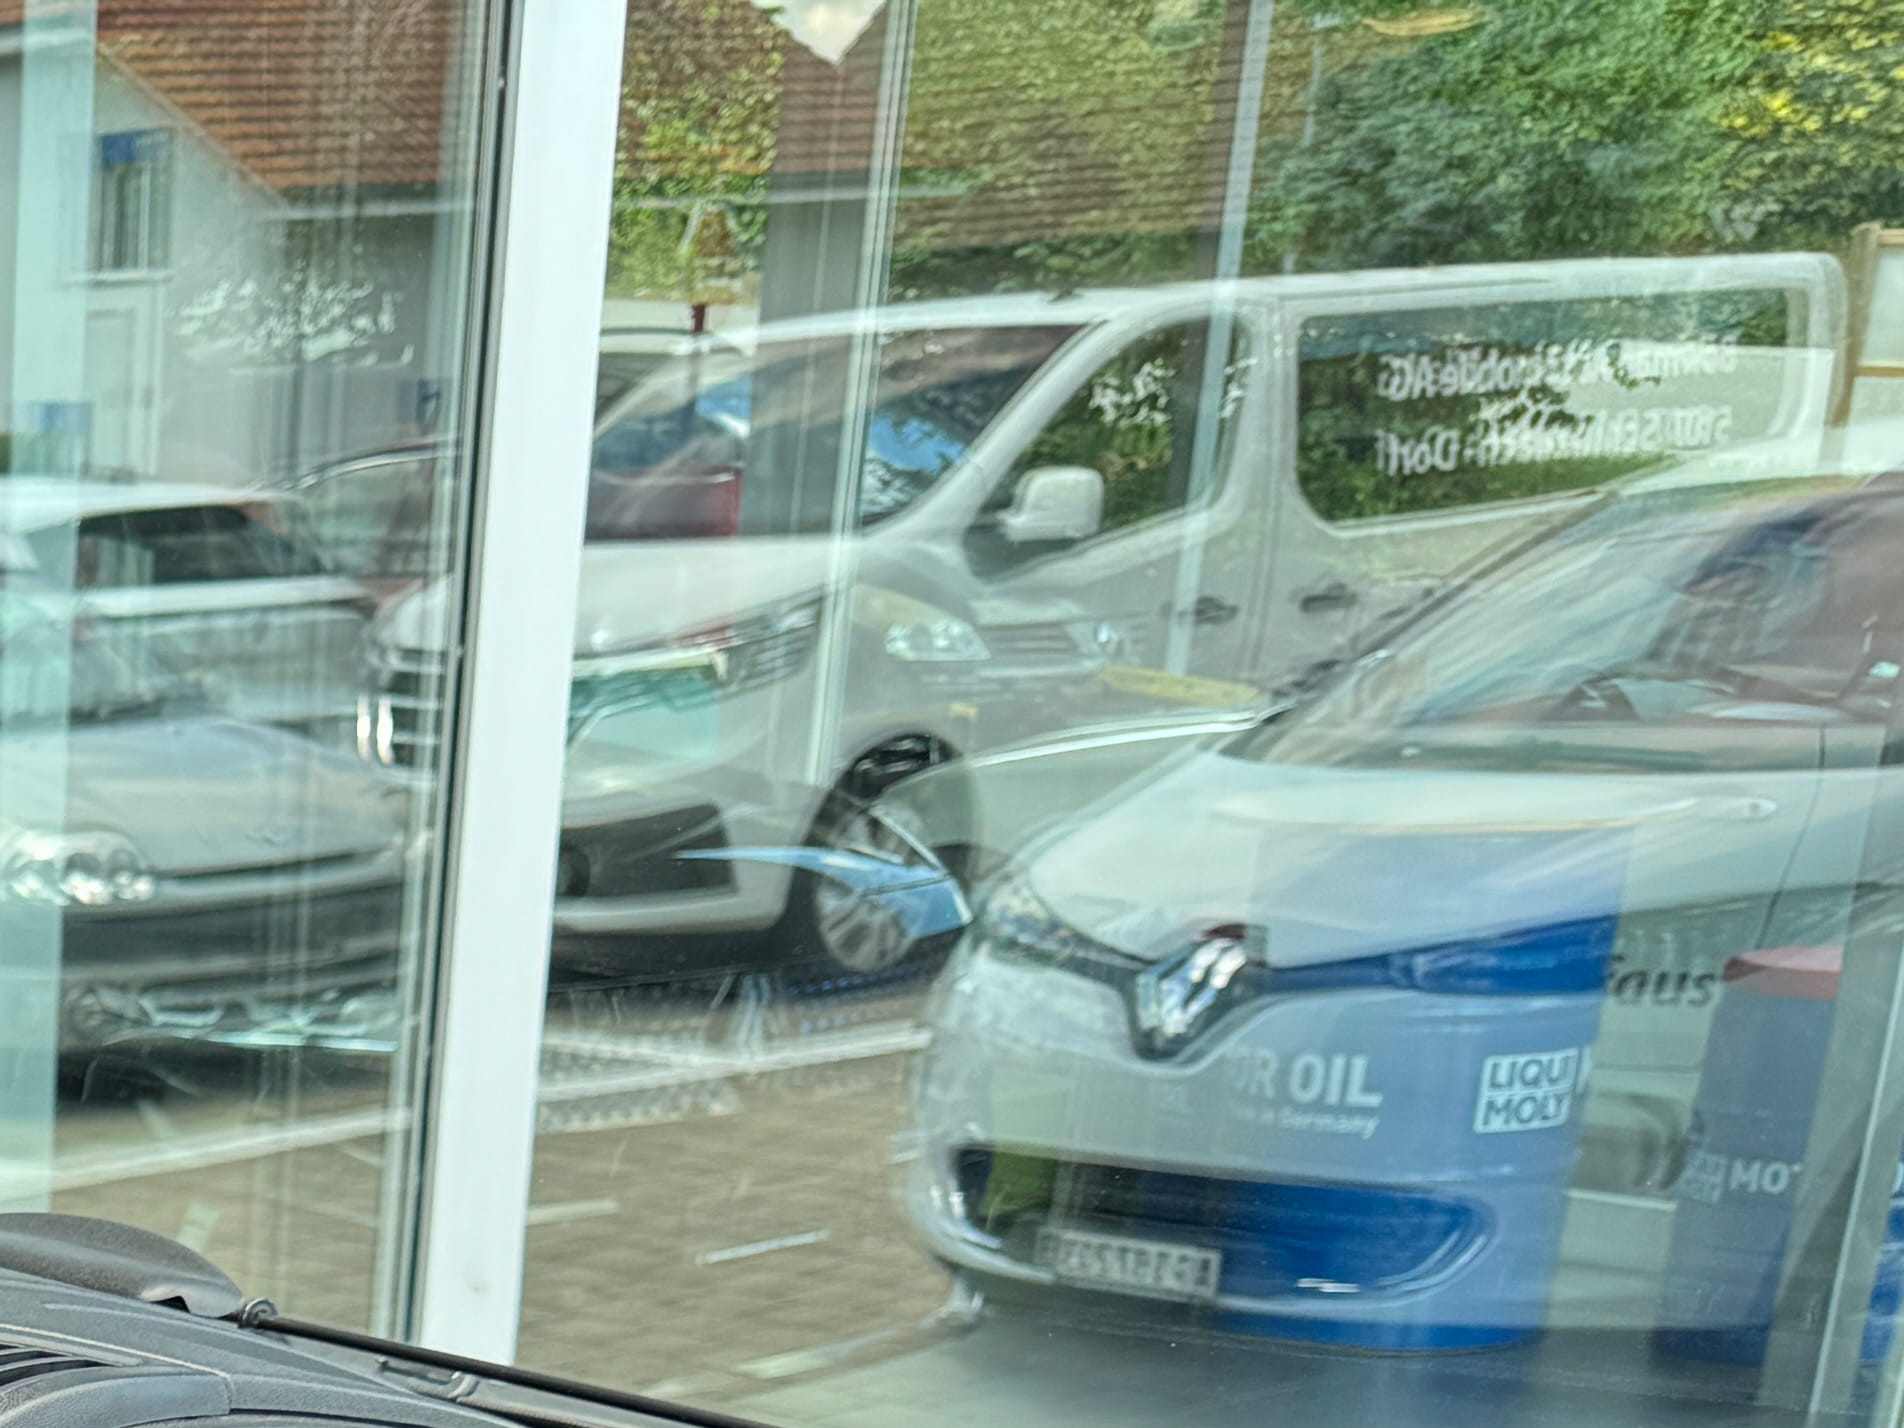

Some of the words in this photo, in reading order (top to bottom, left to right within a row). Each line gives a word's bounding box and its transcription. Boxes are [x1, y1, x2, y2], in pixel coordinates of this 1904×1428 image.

[1288, 1051, 1383, 1108] OIL
[1489, 1056, 1574, 1088] LIQUI
[1481, 1094, 1570, 1126] MOLY
